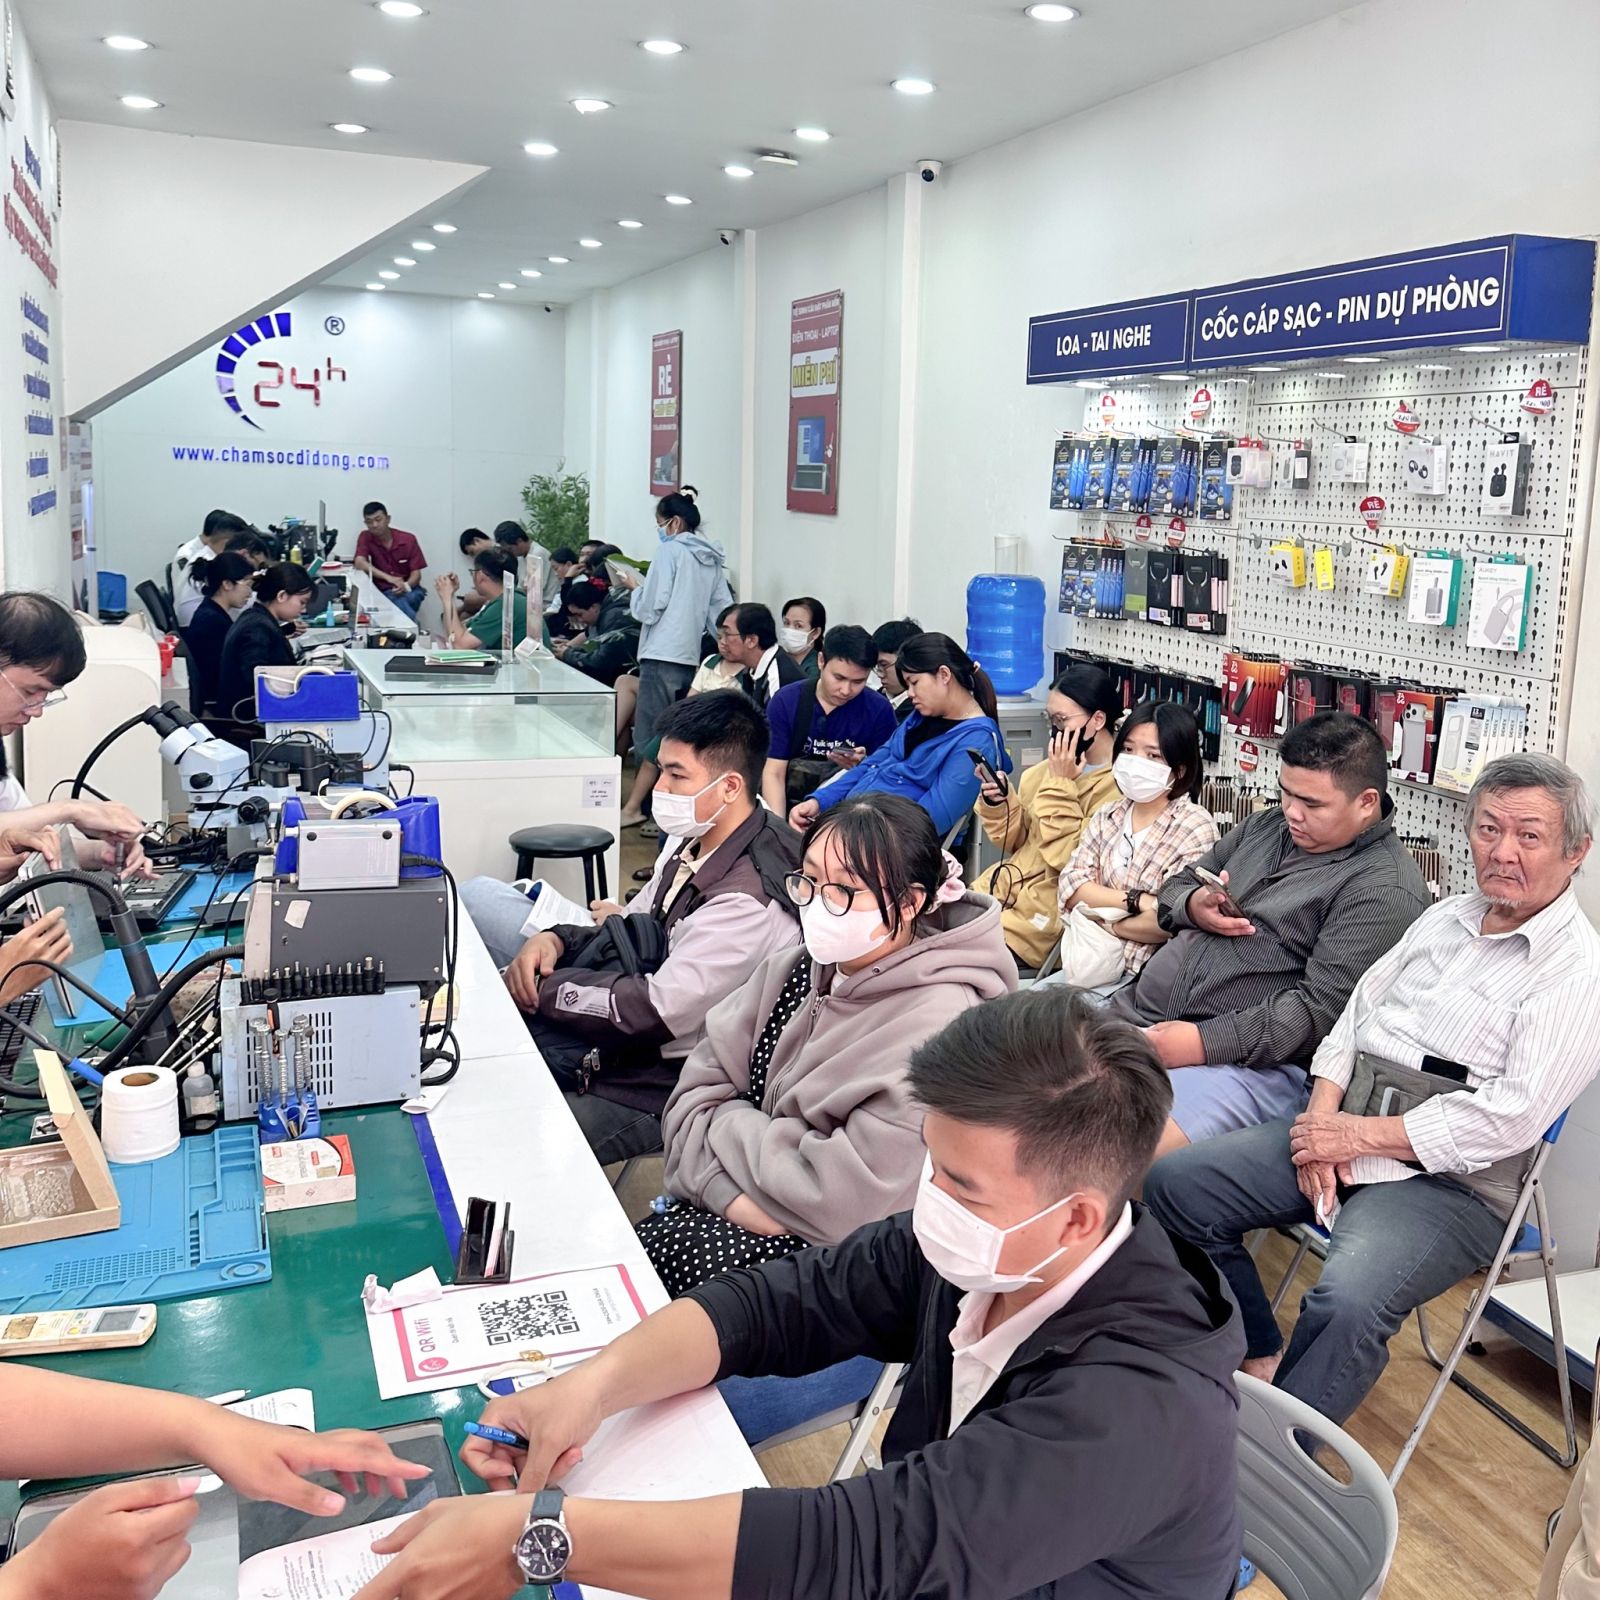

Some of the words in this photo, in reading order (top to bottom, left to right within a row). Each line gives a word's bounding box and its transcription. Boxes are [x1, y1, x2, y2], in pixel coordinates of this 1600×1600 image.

[1201, 306, 1239, 341] CỐC
[1243, 302, 1280, 336] CÁP
[1283, 302, 1321, 337] SẠC
[1337, 295, 1371, 324] PIN
[1376, 285, 1409, 326] DỰ
[1412, 274, 1500, 315] PHÒNG
[1056, 334, 1080, 356] LOA
[1091, 330, 1109, 352] TAI
[1112, 324, 1152, 349] NGHE
[658, 354, 672, 396] RẺ
[793, 355, 819, 388] MIỄN
[820, 353, 837, 386] PHÍ
[172, 446, 390, 471] www.chamsocdidong.com
[414, 1318, 432, 1337] Wifi
[419, 1337, 435, 1353] QR
